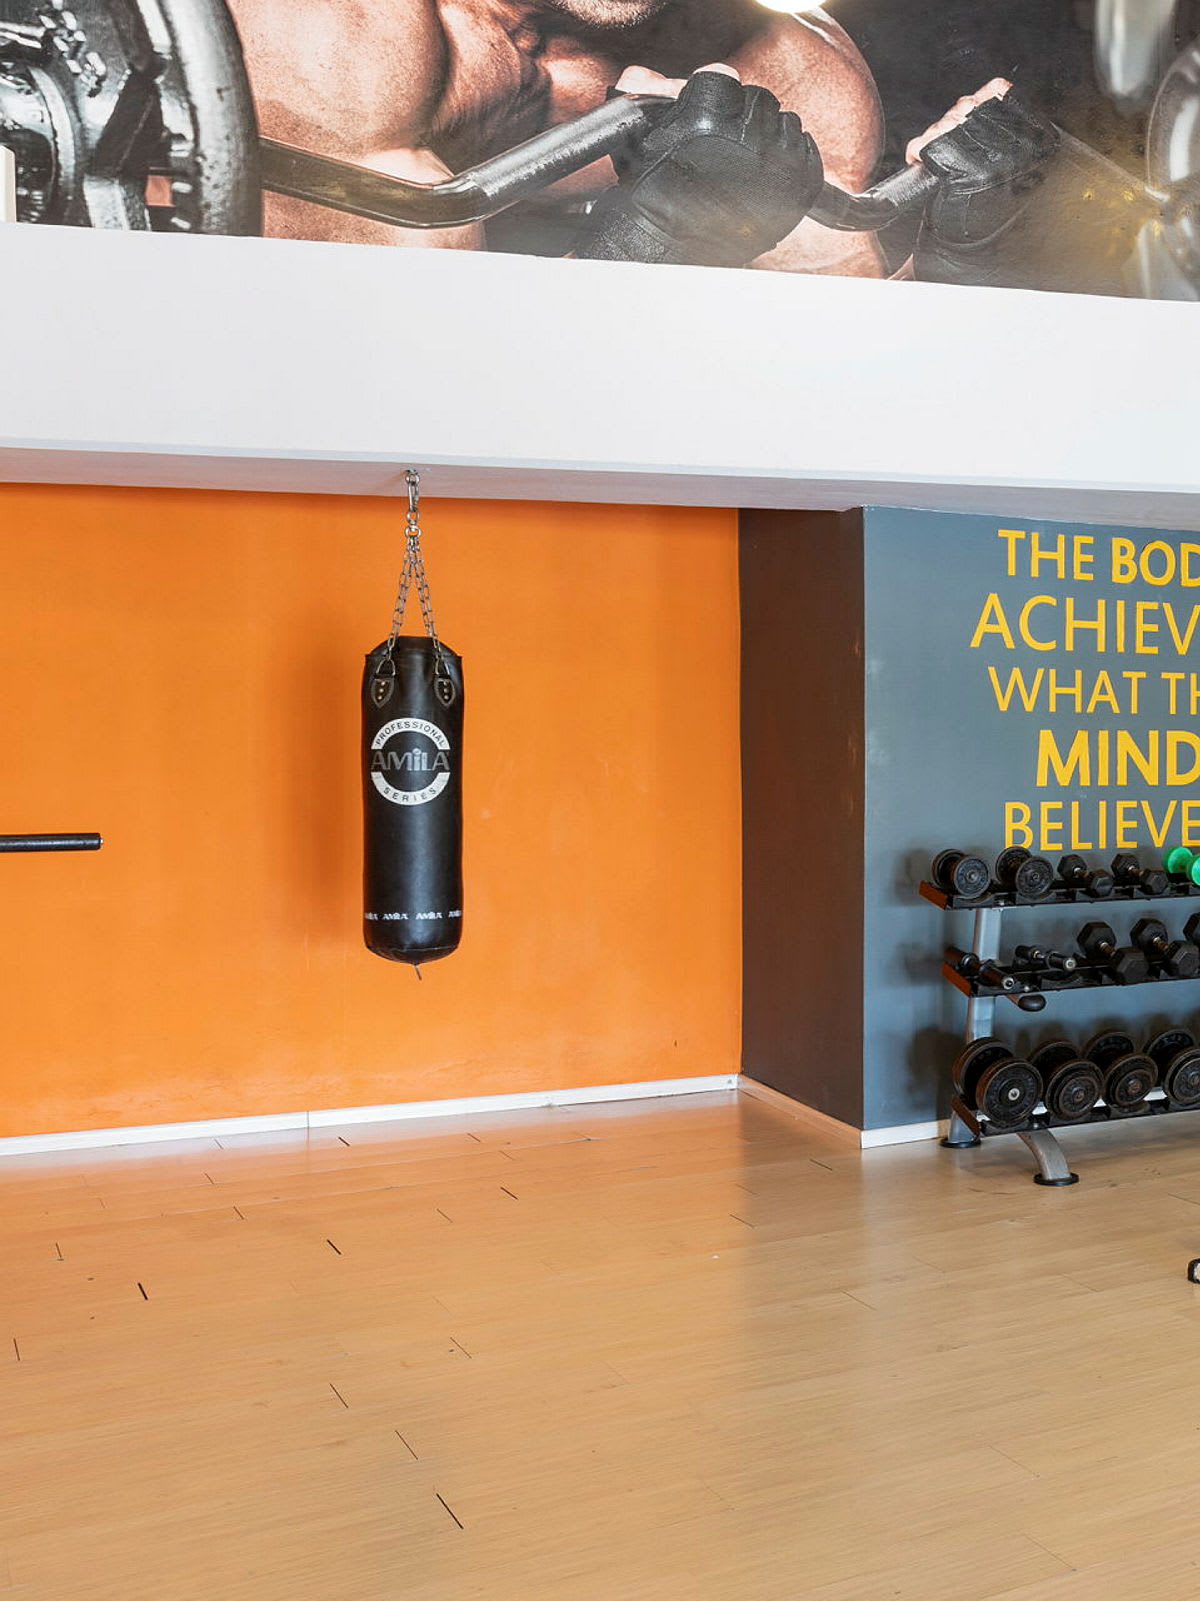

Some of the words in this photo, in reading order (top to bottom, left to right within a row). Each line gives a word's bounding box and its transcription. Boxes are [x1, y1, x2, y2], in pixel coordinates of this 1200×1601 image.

[997, 529, 1095, 581] THE
[987, 666, 1147, 715] WHAT
[375, 721, 445, 746] PROFESSIONAL
[383, 787, 437, 802] SERIES
